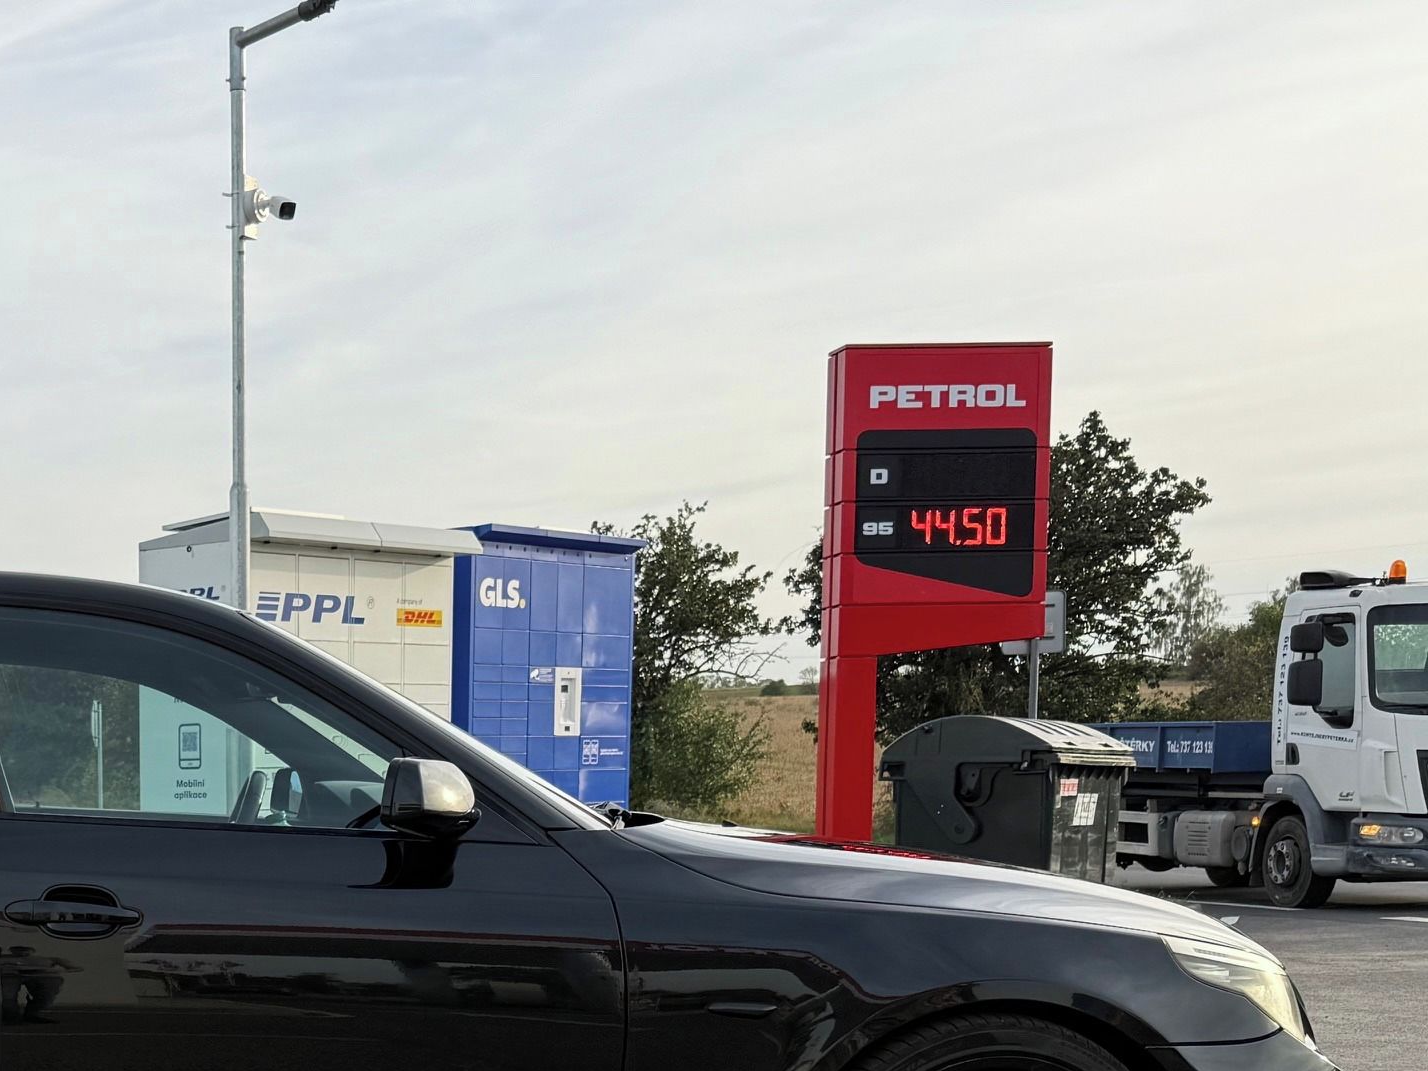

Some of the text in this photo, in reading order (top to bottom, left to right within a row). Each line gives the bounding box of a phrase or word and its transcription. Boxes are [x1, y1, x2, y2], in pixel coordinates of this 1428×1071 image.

[869, 383, 1026, 409] PETROL
[869, 468, 889, 485] D
[862, 521, 894, 536] 95
[179, 586, 220, 601] PL
[280, 592, 366, 625] PPL
[403, 610, 436, 624] DHL
[1180, 740, 1192, 753] 737
[1192, 740, 1204, 753] 123
